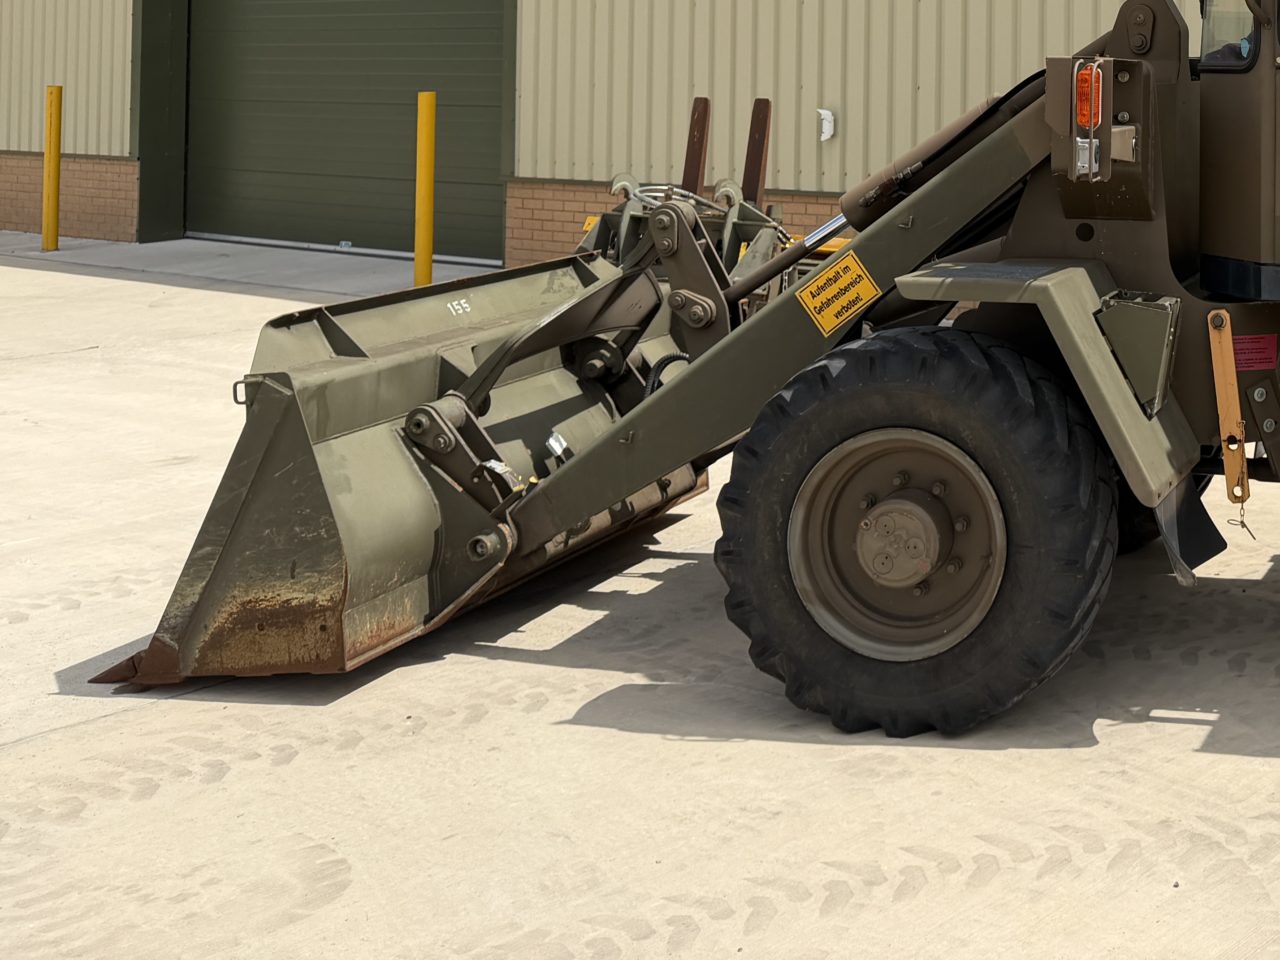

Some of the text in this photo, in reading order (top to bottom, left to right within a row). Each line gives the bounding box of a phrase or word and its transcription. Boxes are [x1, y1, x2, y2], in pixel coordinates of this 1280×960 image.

[809, 264, 852, 300] Aufenthalt im
[813, 273, 865, 316] Gefahrenbereich
[447, 299, 470, 316] 155
[833, 292, 864, 320] verboten!
